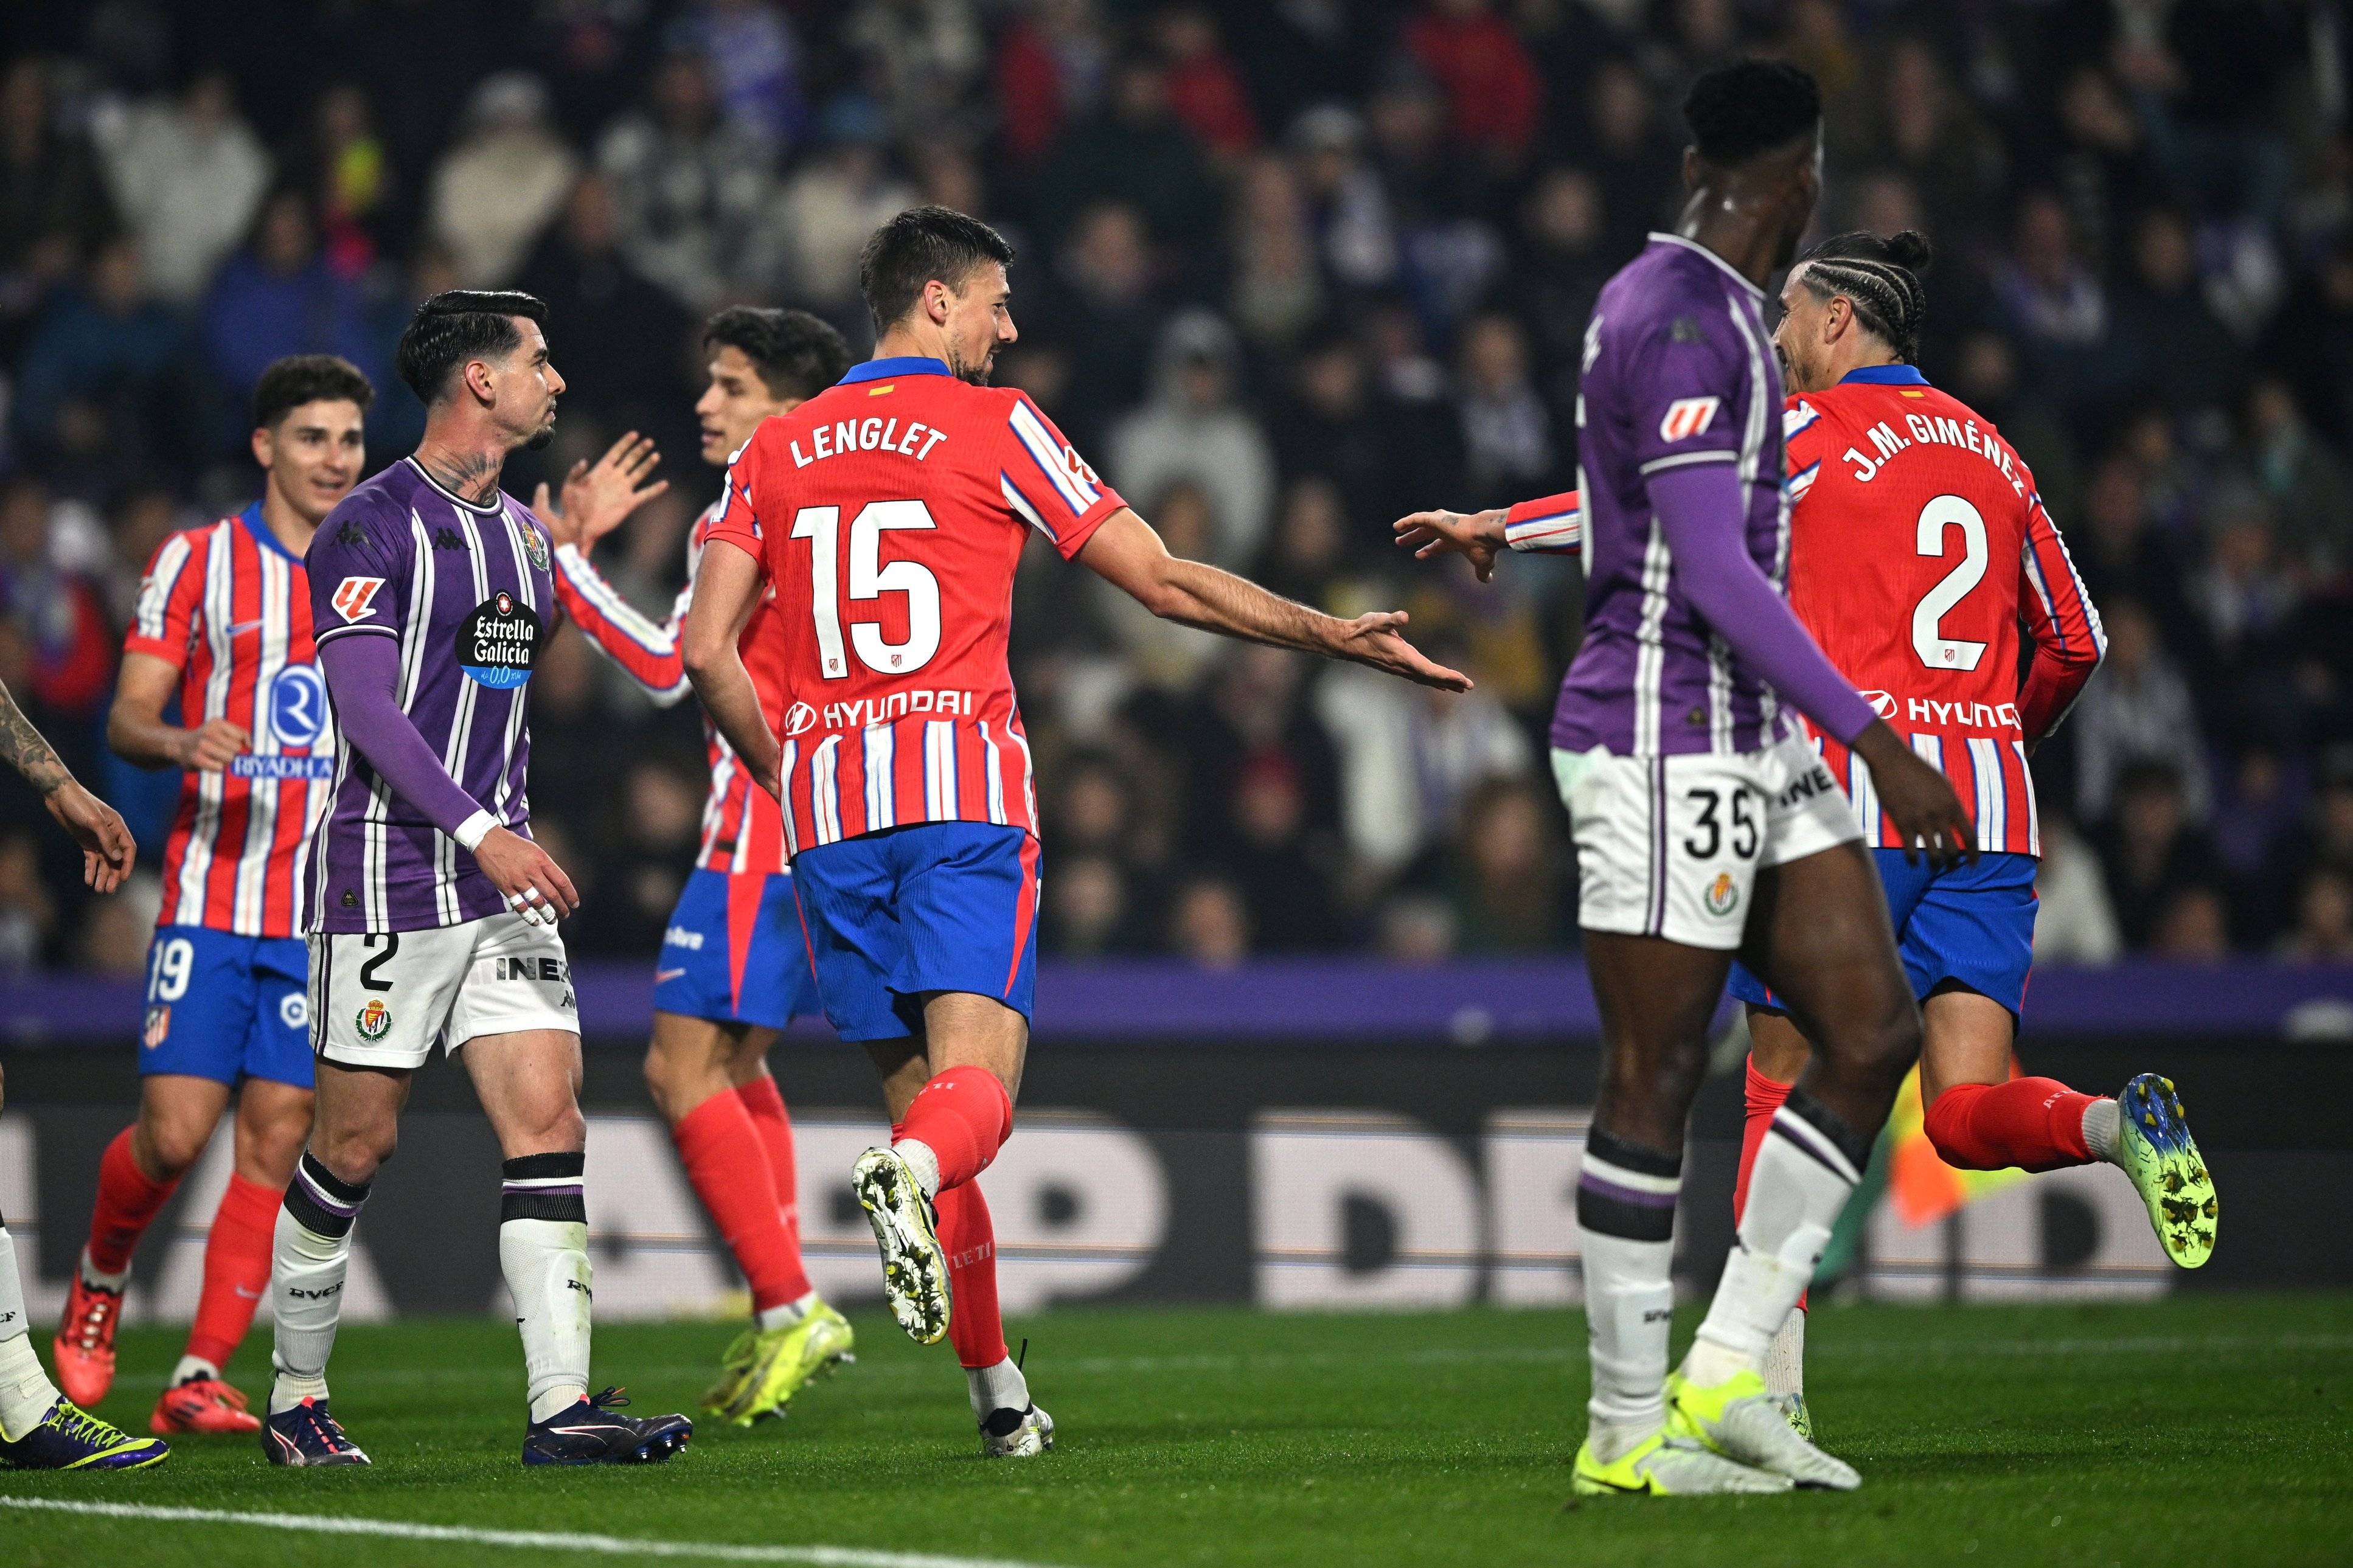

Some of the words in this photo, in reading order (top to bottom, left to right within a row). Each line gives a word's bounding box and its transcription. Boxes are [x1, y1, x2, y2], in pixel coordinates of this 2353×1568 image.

[790, 417, 947, 470] LENGLET
[790, 499, 942, 679] 15
[1912, 494, 1989, 670] 2
[474, 616, 534, 641] Estrella
[474, 639, 529, 664] Galicia
[824, 690, 971, 729] HYUNDAI
[1684, 788, 1757, 860] 35
[148, 938, 194, 1002] 19
[360, 932, 399, 992] 2
[290, 1281, 344, 1300] RVCF
